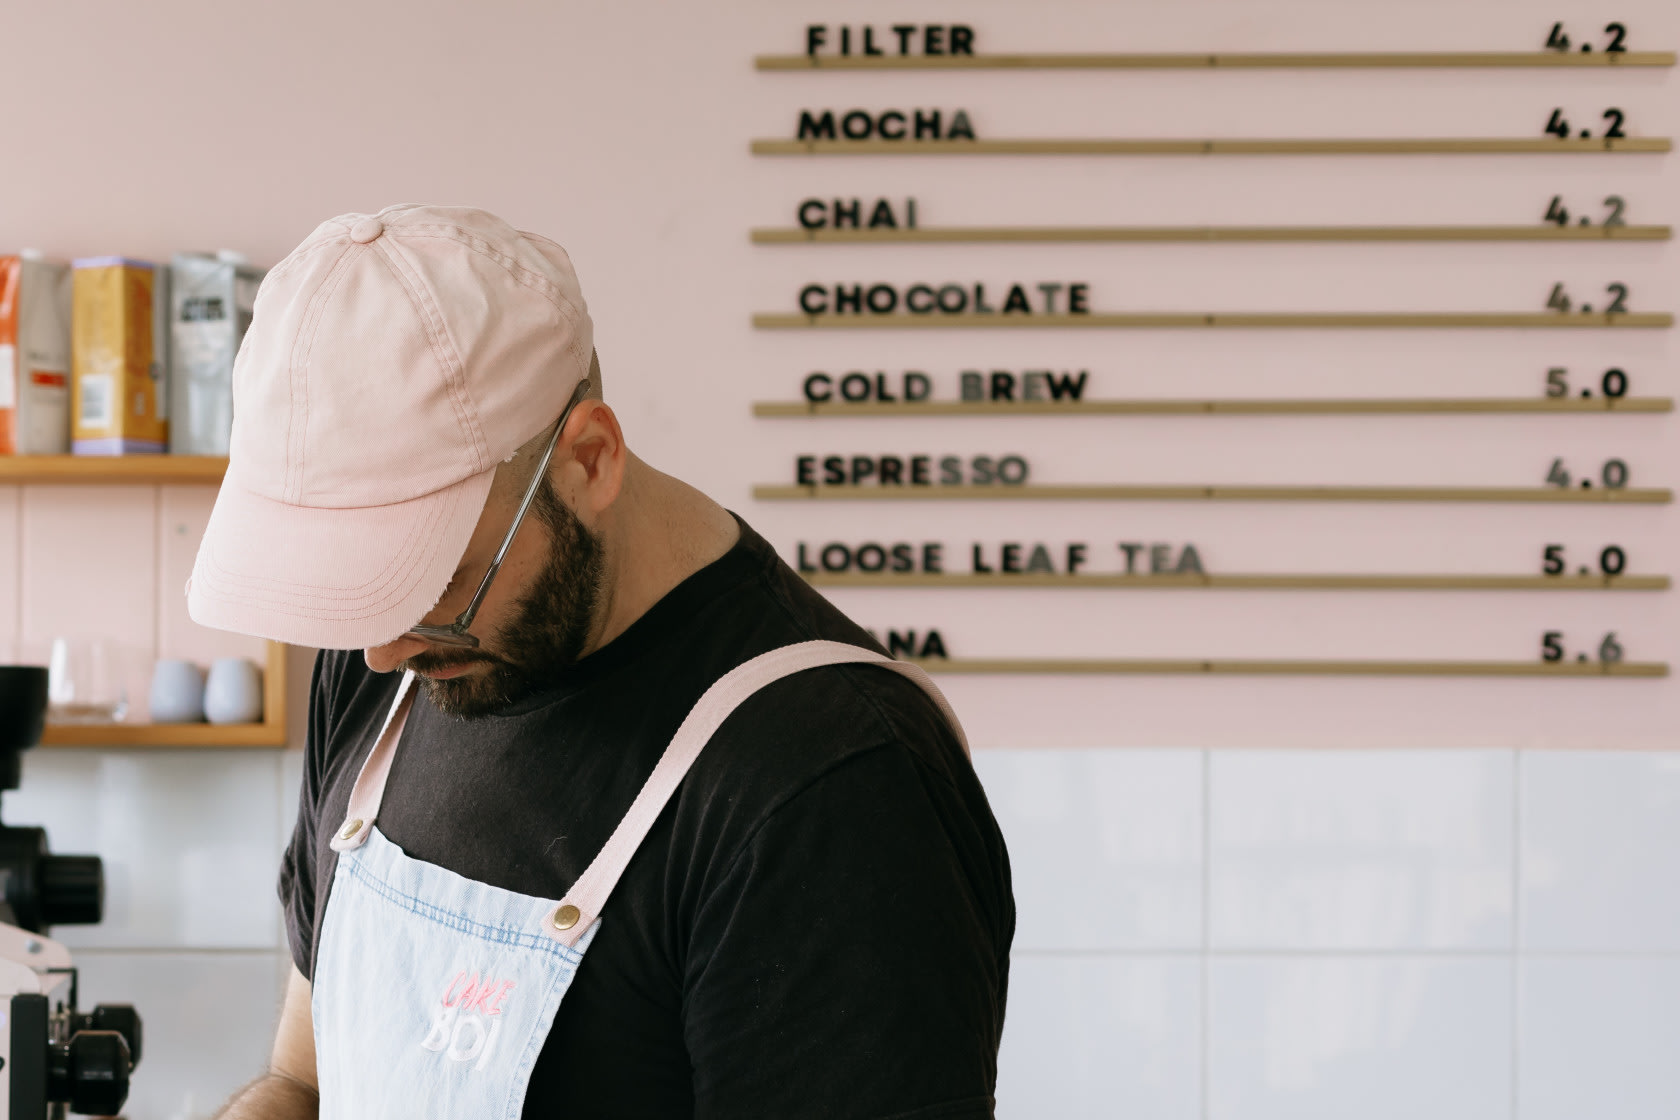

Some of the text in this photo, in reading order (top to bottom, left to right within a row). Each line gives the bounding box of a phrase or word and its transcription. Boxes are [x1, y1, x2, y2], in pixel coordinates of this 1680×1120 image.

[805, 21, 1628, 57] FILTER 4.2
[796, 106, 1627, 141] MOCHA 4.2
[797, 195, 1626, 230] CHAI 4.2
[798, 282, 1629, 315] CHOCOLATE 4.2
[802, 368, 1629, 403] COLD BREW 5.0
[795, 454, 1630, 489] ESPRESSO 4.0
[797, 542, 1628, 577] LOOSE LEAF TEA 5.0
[1540, 631, 1623, 663] 5.6
